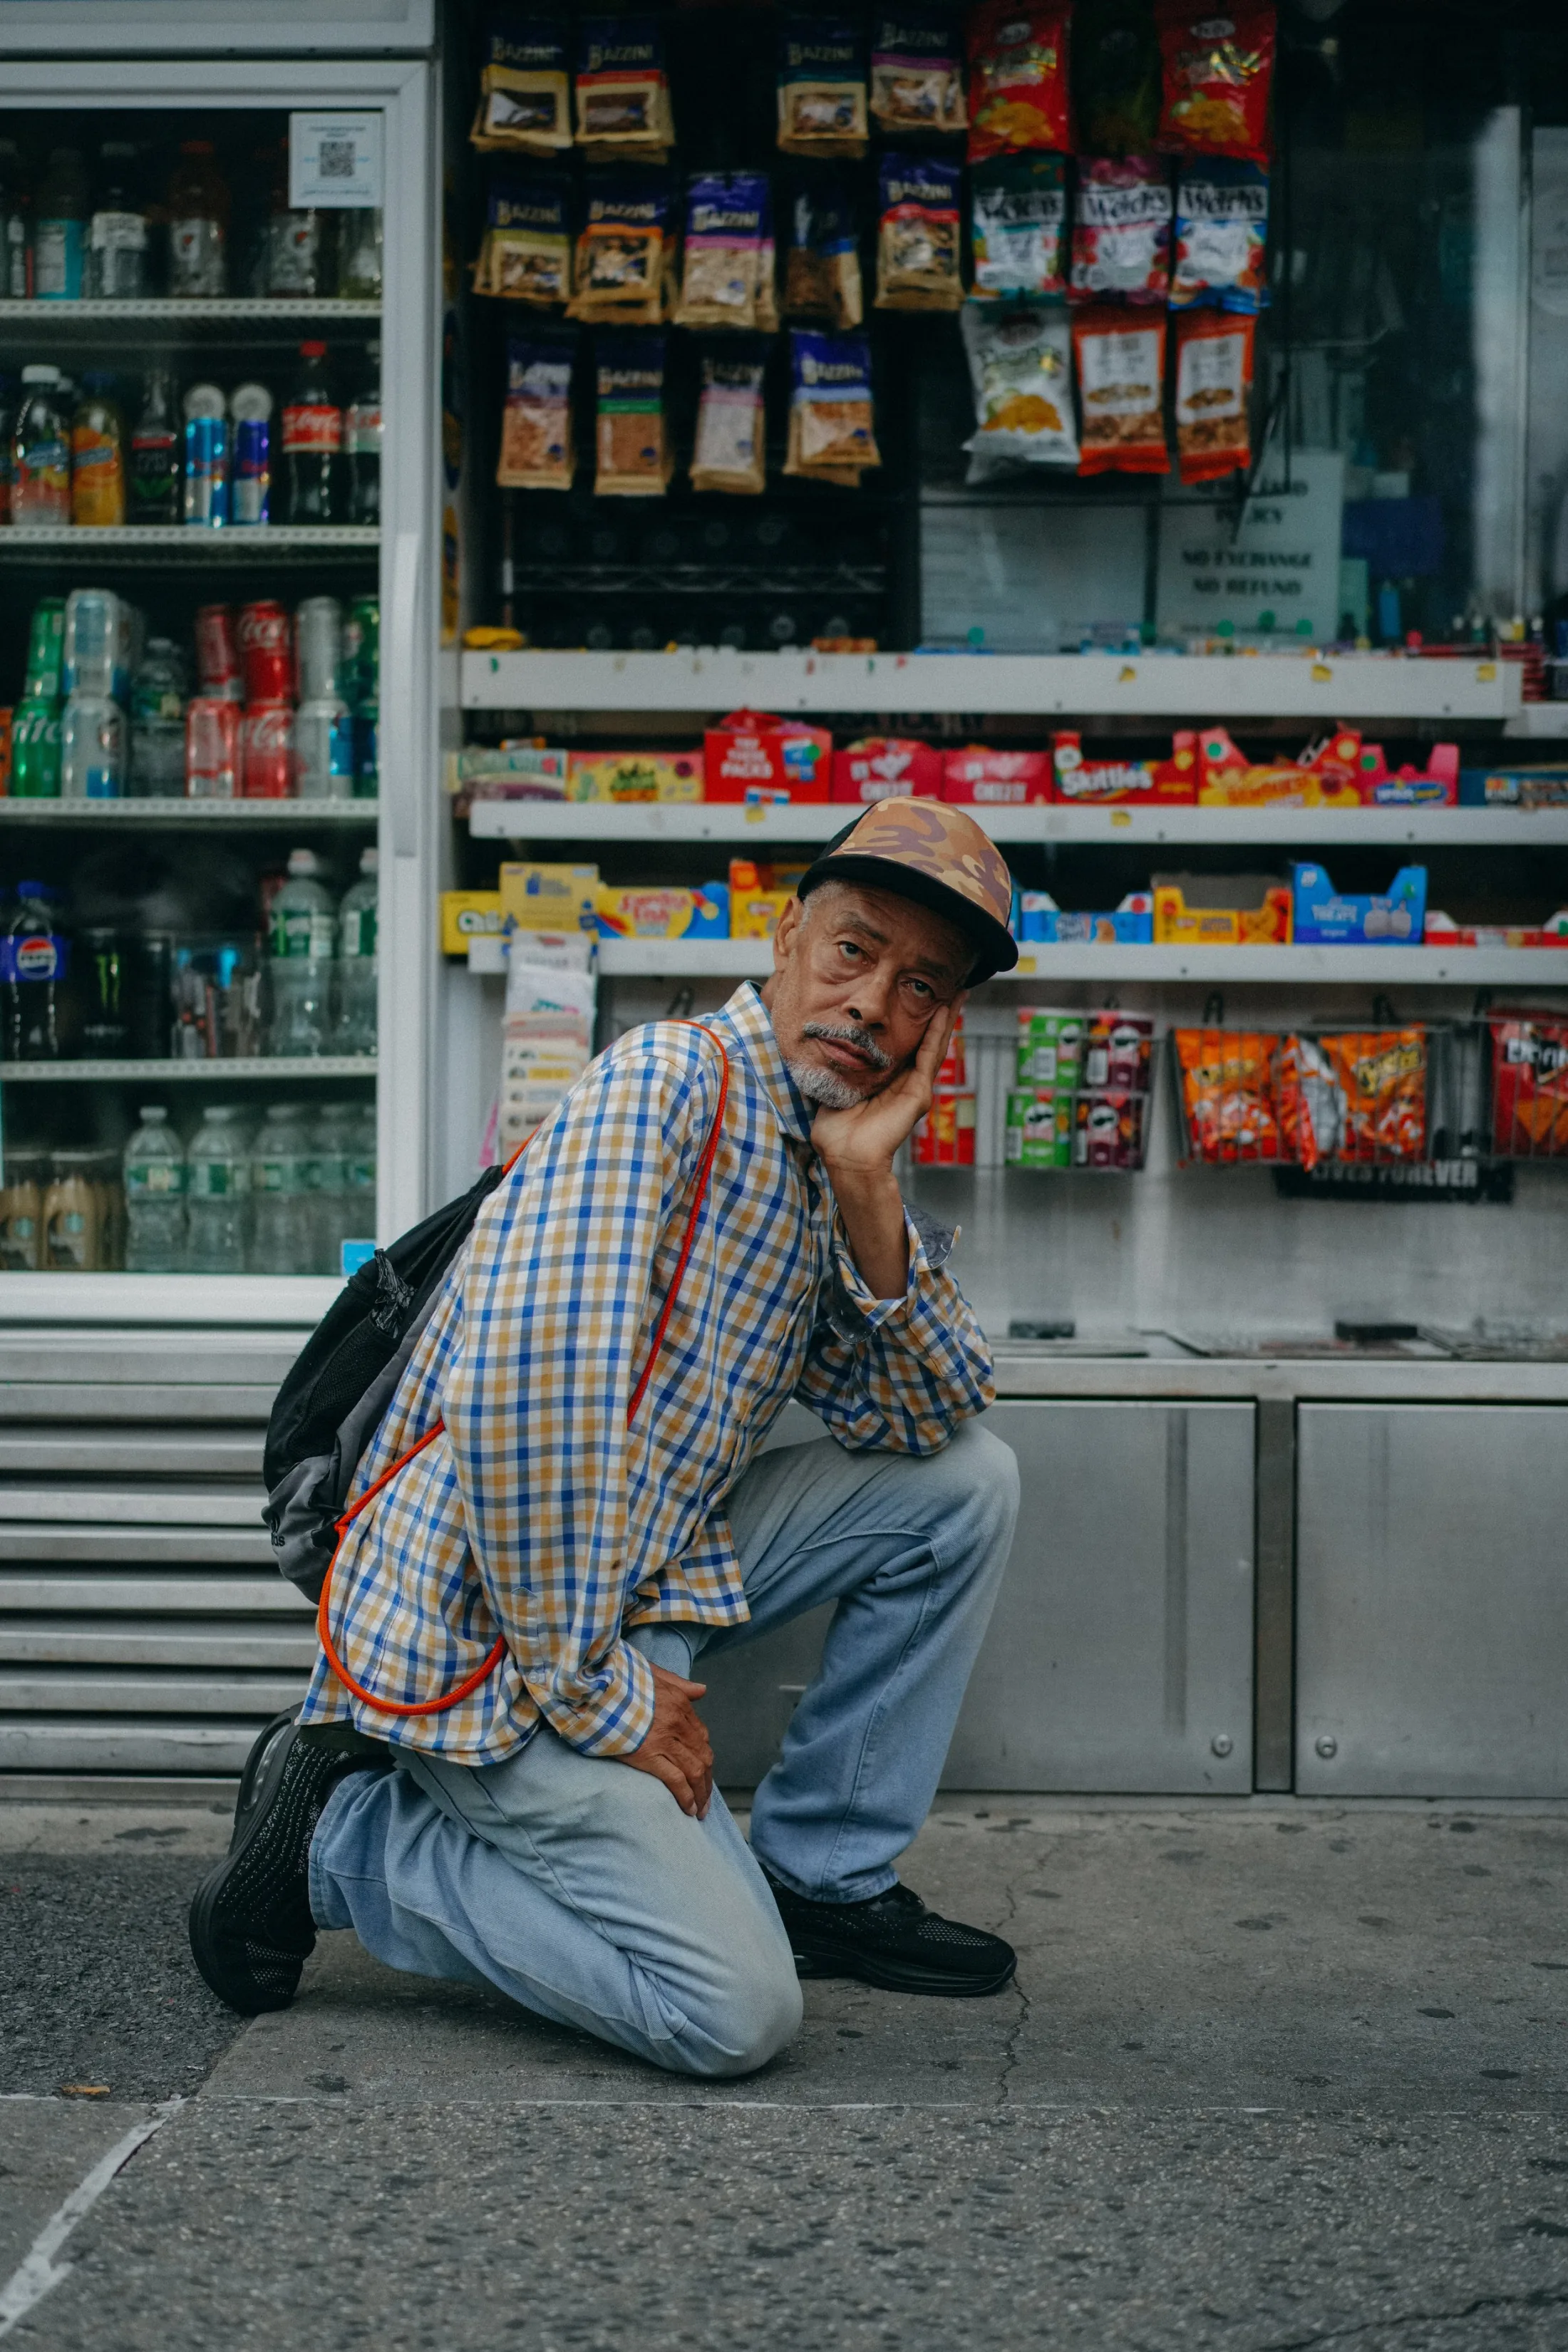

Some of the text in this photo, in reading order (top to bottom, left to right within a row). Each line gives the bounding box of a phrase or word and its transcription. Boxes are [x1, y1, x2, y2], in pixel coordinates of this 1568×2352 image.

[1182, 550, 1311, 567] NO EXCHANGE
[1194, 578, 1302, 596] NO REFUND
[1062, 766, 1153, 796] Skittles
